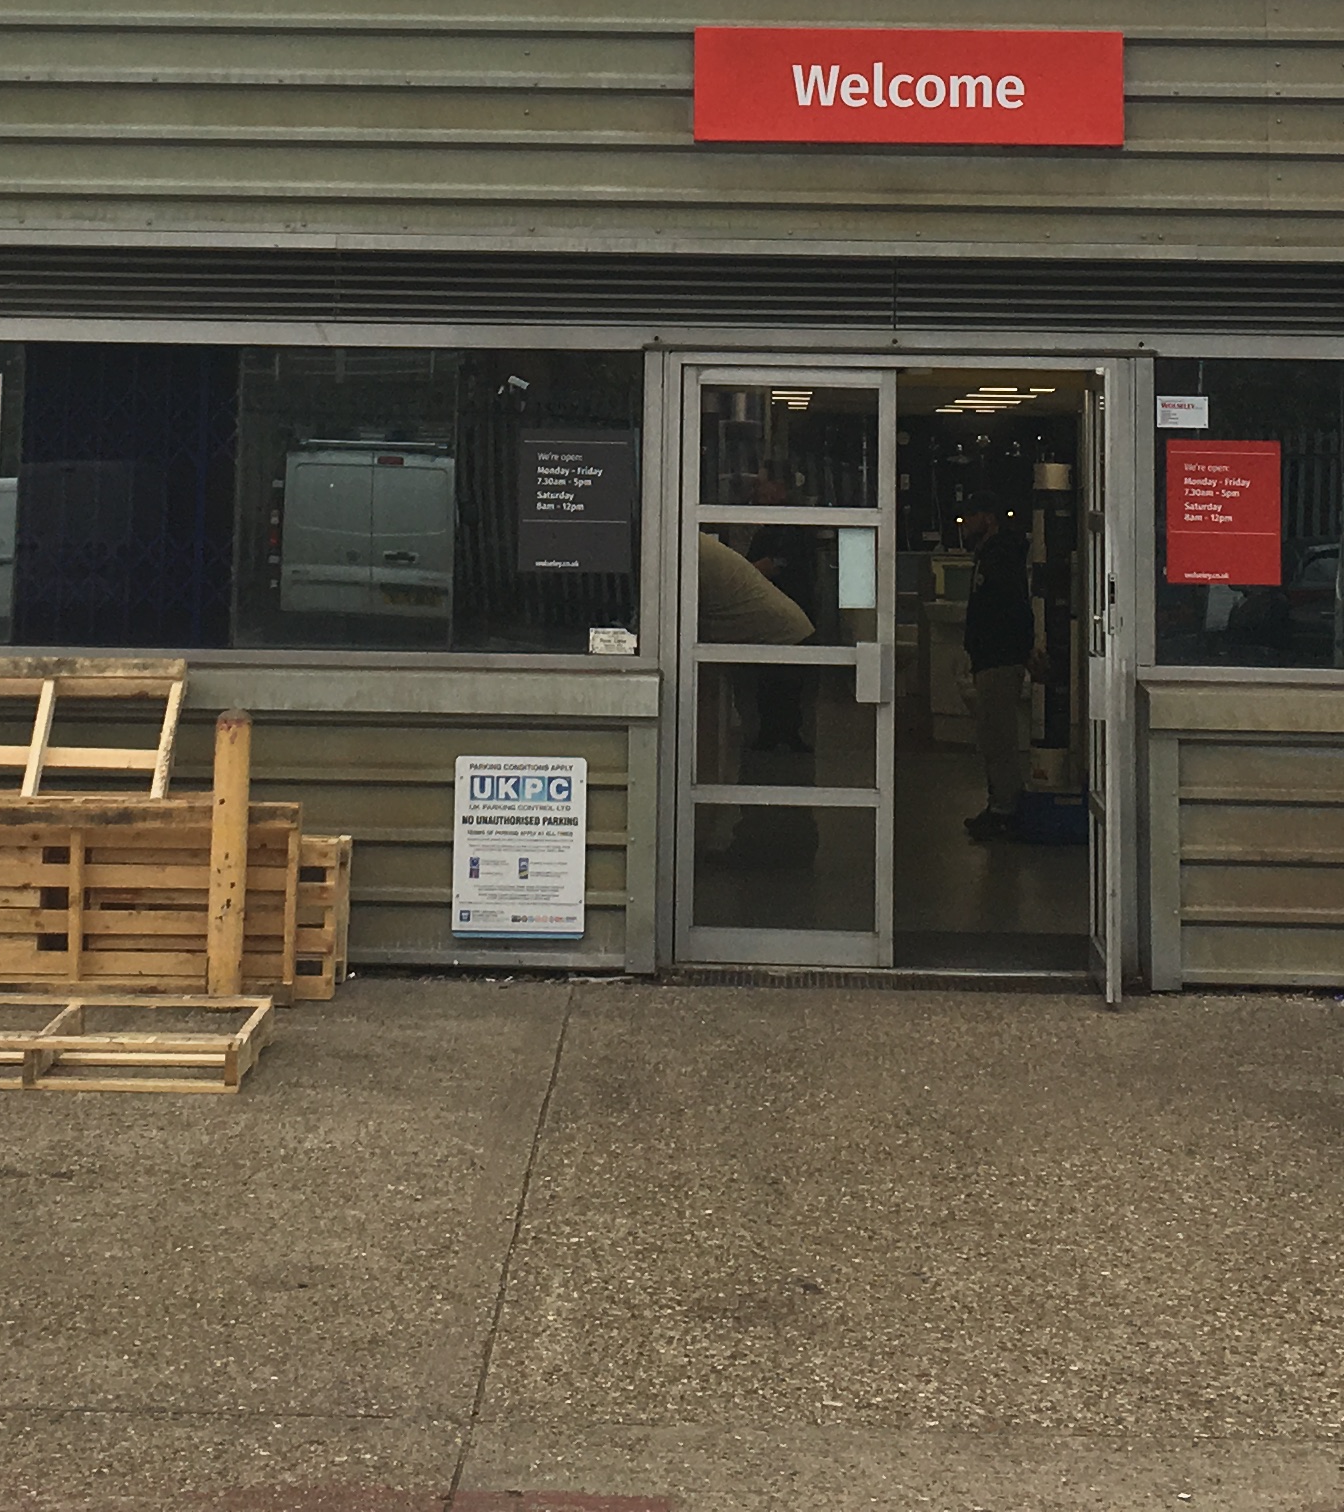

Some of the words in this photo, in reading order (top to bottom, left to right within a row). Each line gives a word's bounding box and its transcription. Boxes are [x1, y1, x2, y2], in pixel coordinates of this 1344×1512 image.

[792, 61, 1025, 109] Welcome
[538, 453, 559, 461] We're
[537, 466, 569, 475] Monday
[577, 466, 603, 476] Friday
[1184, 463, 1205, 471] We're
[573, 478, 592, 486] 5pm
[1184, 478, 1217, 487] Monday
[1225, 478, 1250, 488] Friday
[537, 491, 574, 501] Saturday
[1184, 489, 1213, 497] 7.30am
[1221, 489, 1240, 498] 5pm
[563, 503, 584, 511] 12pm
[1184, 503, 1222, 512] Saturday
[1211, 514, 1232, 523] 12pm
[473, 777, 569, 800] UKPC
[462, 816, 474, 824] NO
[476, 816, 540, 825] UNAUTHORISED
[543, 817, 578, 826] PARKING
